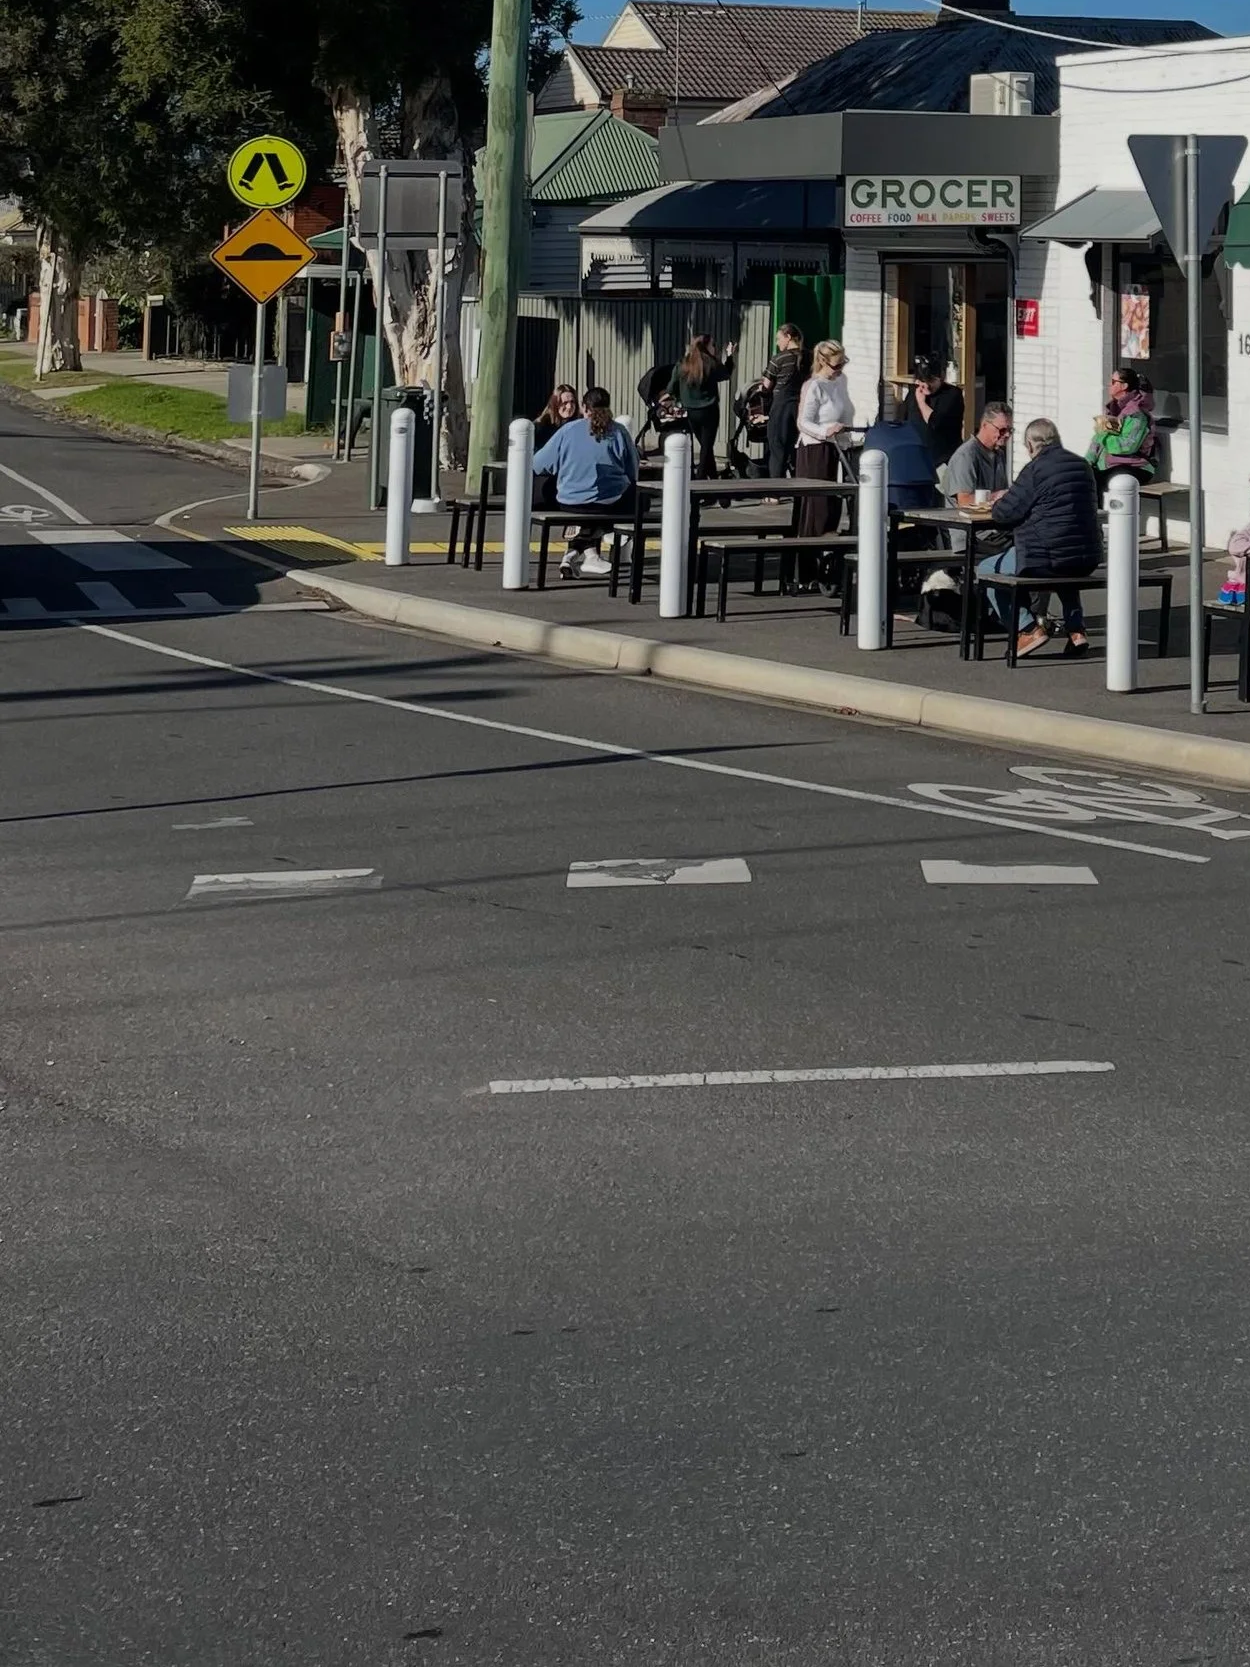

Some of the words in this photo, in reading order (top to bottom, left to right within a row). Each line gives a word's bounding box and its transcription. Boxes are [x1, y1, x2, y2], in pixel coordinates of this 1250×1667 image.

[851, 179, 1015, 208] GROCER
[850, 213, 882, 223] COFFEE
[887, 213, 912, 223] FOOD
[917, 213, 937, 223] MILK
[943, 213, 976, 223] PAPERS
[981, 212, 1015, 222] SWEETS
